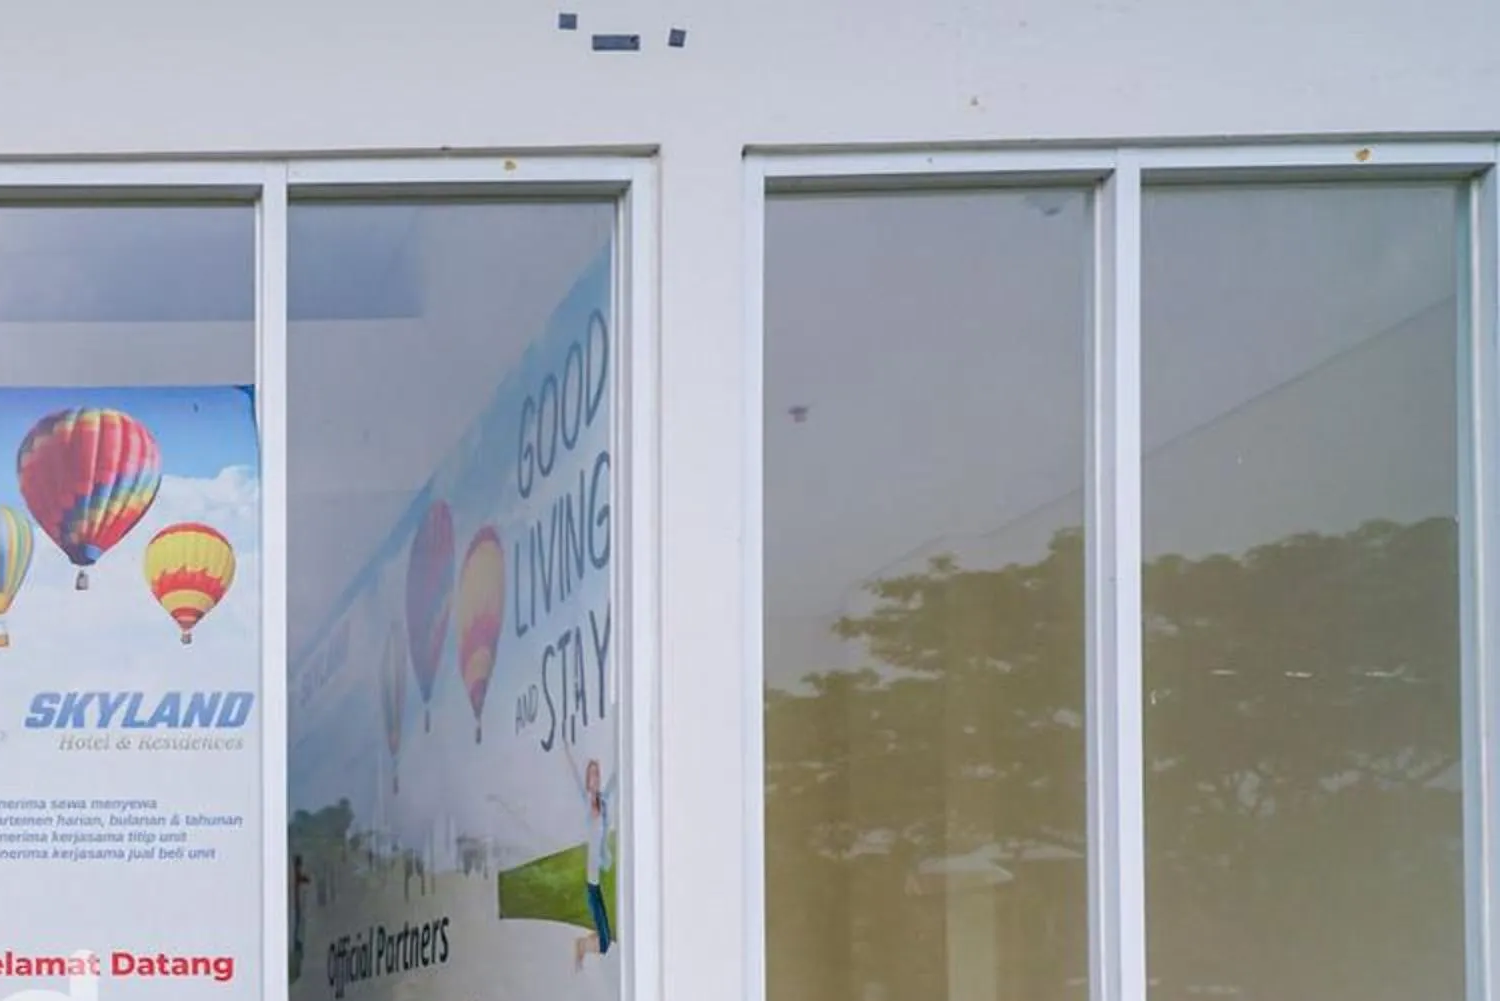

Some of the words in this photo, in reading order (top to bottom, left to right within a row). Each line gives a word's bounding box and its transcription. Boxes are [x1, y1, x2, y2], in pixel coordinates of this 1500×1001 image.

[517, 308, 608, 499] GOOD
[514, 450, 611, 638] LIVING
[541, 601, 611, 752] STAY
[24, 692, 255, 728] SKYLAND
[58, 734, 110, 750] Hotel
[116, 735, 132, 750] &
[138, 734, 244, 750] Residences
[50, 799, 87, 810] sewa
[90, 799, 158, 812] menyewa
[109, 814, 167, 826] bulanan
[169, 814, 180, 826] &
[185, 814, 243, 826] tahunan
[51, 831, 124, 845] kerjasama
[159, 831, 187, 843] unit
[51, 848, 126, 862] kerjasama
[127, 848, 155, 862] jual
[158, 848, 185, 860] beli
[187, 848, 216, 860] unit
[111, 952, 235, 982] Datang
[328, 926, 373, 998] Official
[376, 917, 450, 977] Partners
